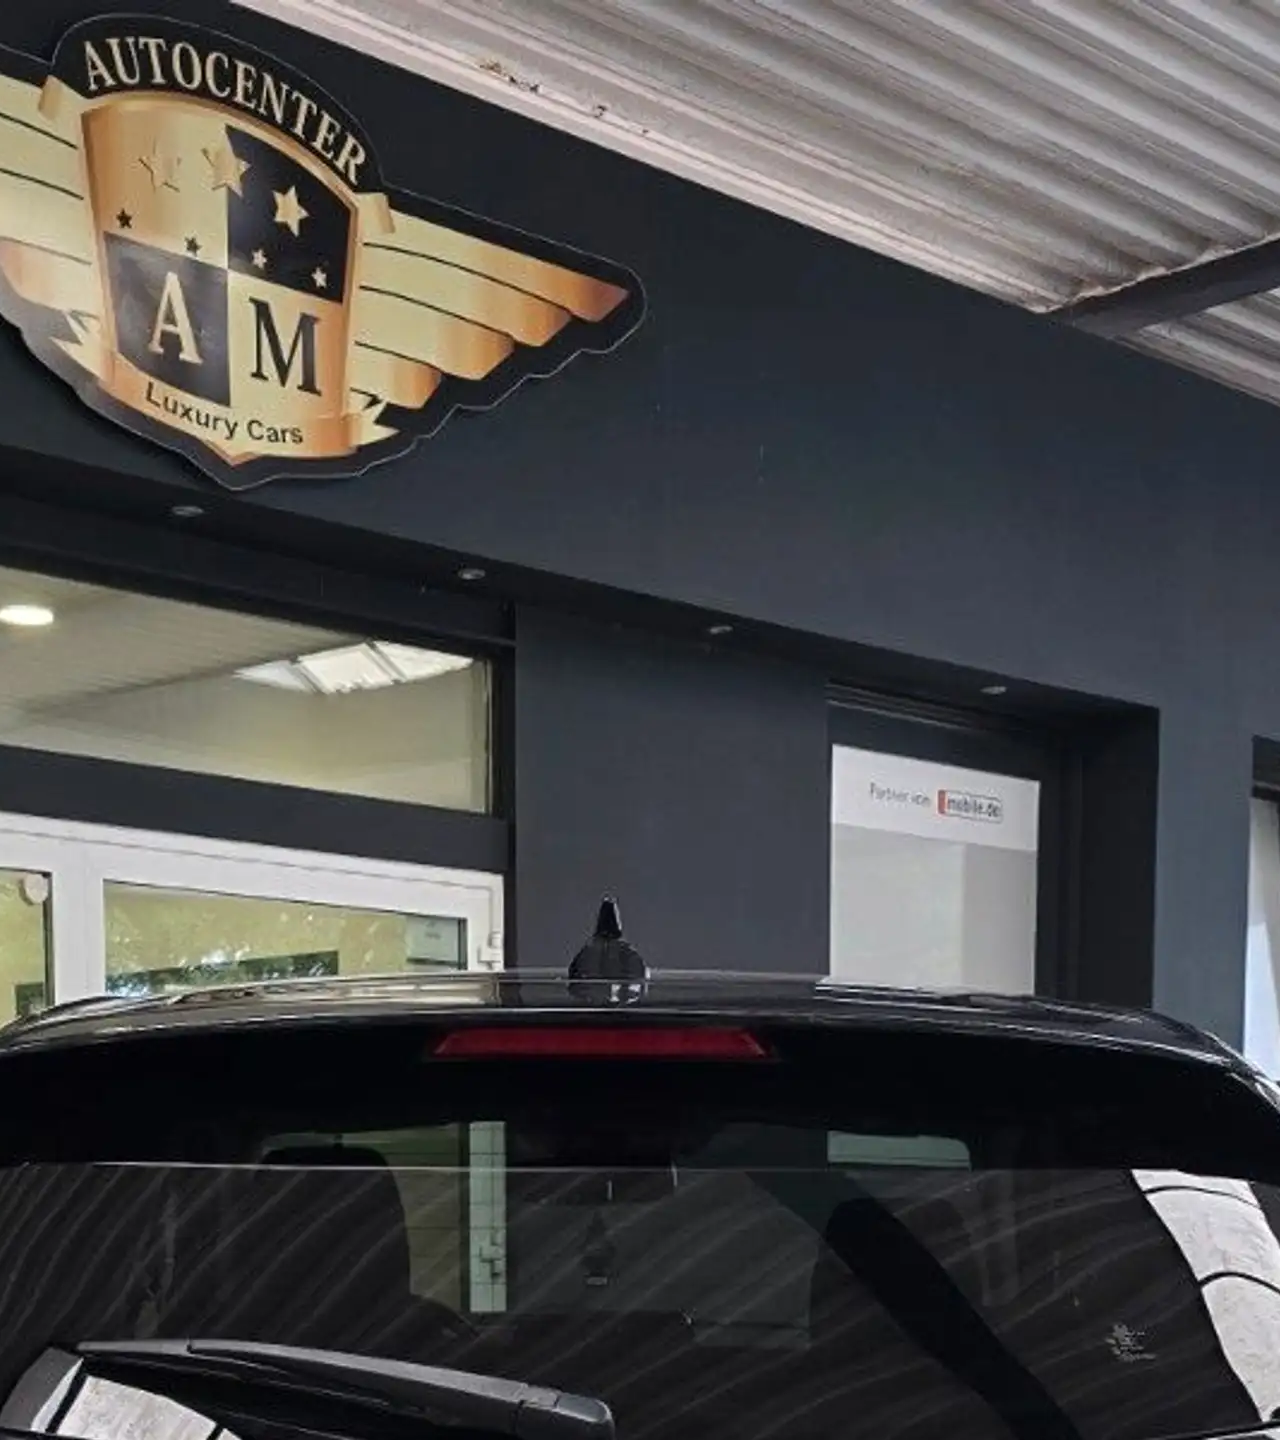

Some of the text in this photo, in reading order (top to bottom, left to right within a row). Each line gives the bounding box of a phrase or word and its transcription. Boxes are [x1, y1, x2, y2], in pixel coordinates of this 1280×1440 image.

[83, 37, 368, 185] AUTOCENTER
[147, 271, 322, 397] A M
[145, 381, 304, 444] Luxury Cars
